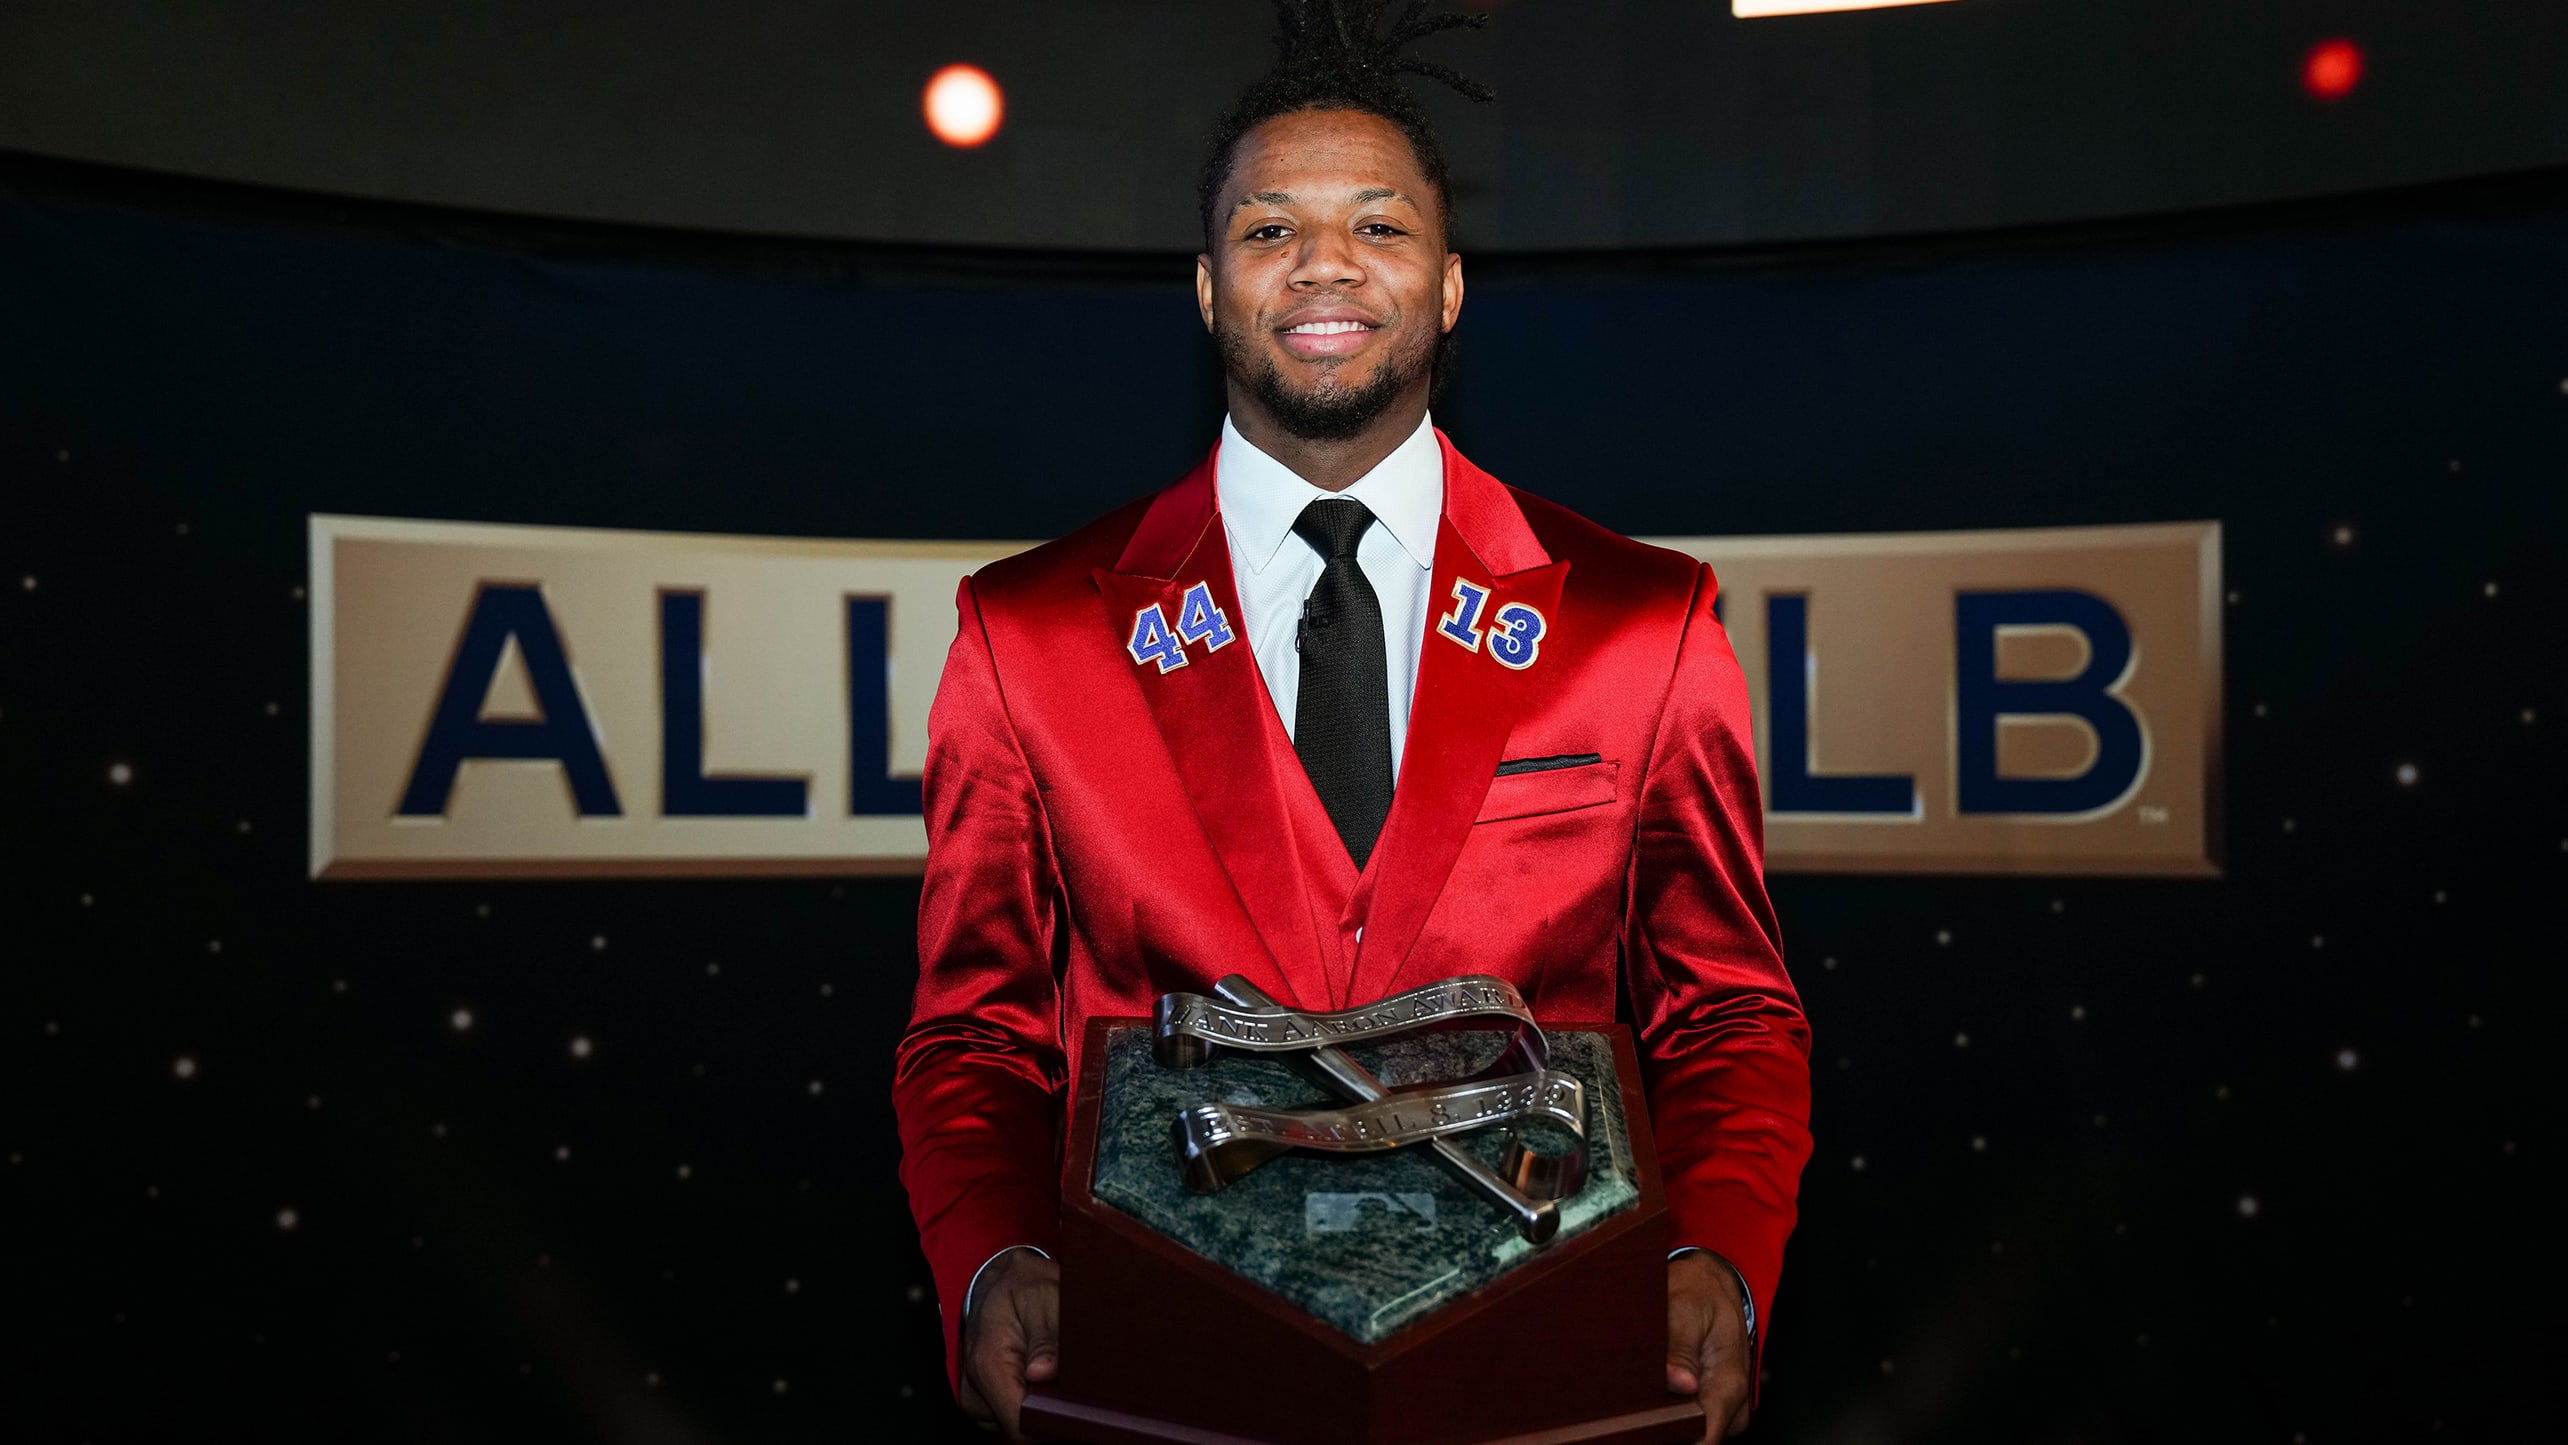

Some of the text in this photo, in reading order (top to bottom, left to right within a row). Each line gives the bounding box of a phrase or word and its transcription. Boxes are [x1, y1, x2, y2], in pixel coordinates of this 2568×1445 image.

[1127, 580, 1235, 675] 44
[1437, 576, 1547, 670] 13
[1716, 587, 2152, 822] LB
[1167, 1004, 1269, 1043] HANK
[1283, 1007, 1400, 1042] AARON
